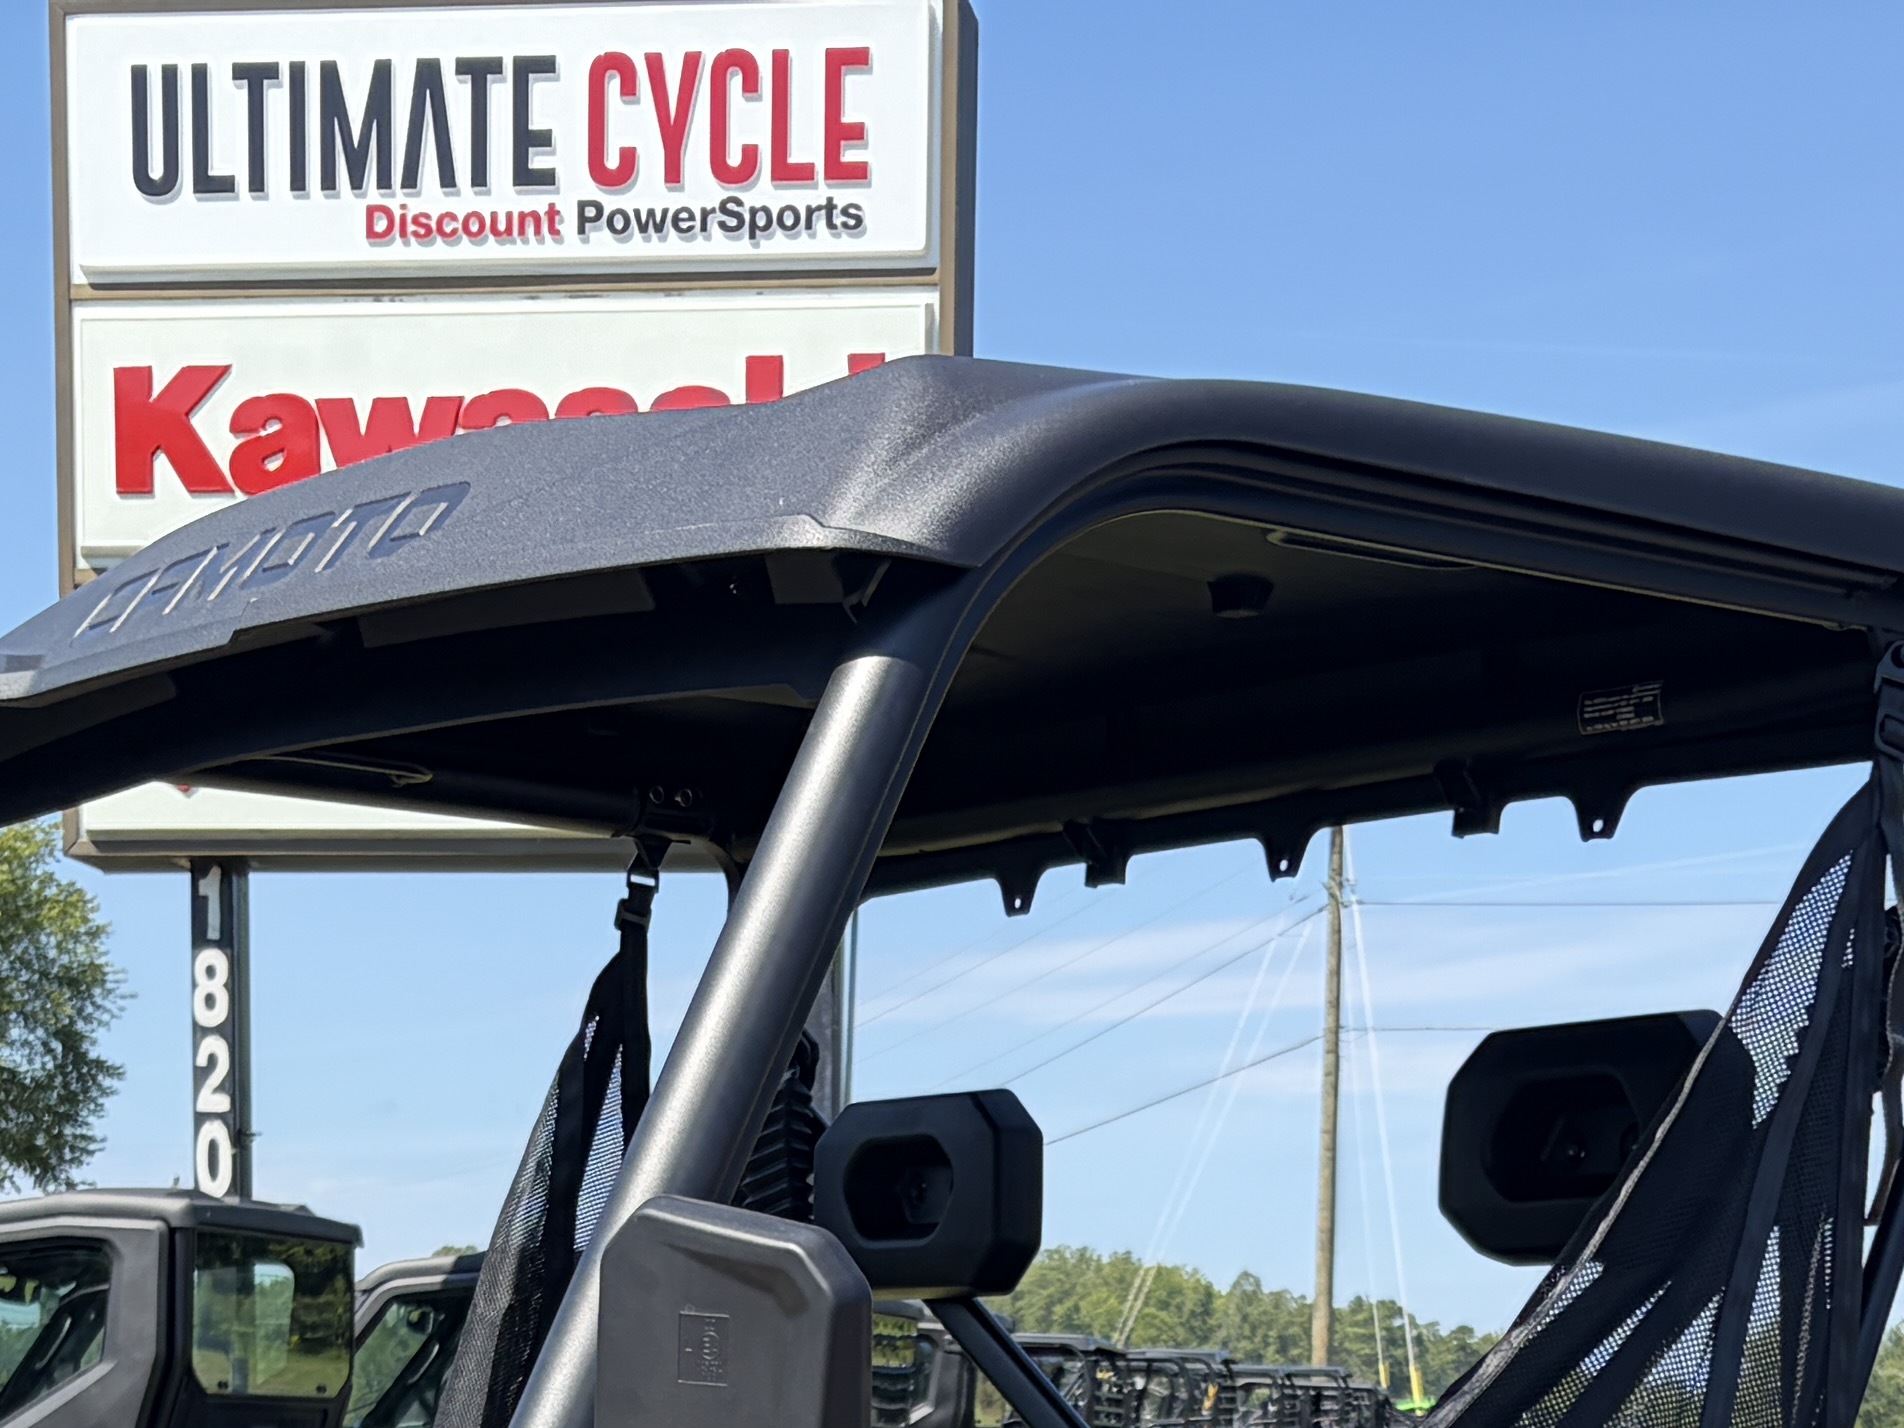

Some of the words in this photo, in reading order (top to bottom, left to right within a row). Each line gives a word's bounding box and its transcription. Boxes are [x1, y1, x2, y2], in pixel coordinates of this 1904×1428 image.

[129, 54, 558, 199] ULTIMATE
[586, 45, 872, 188] CYCLE
[364, 202, 562, 241] Discount
[576, 195, 864, 239] PowerSports
[68, 480, 473, 648] CFMOTO
[192, 865, 233, 1199] 1820
